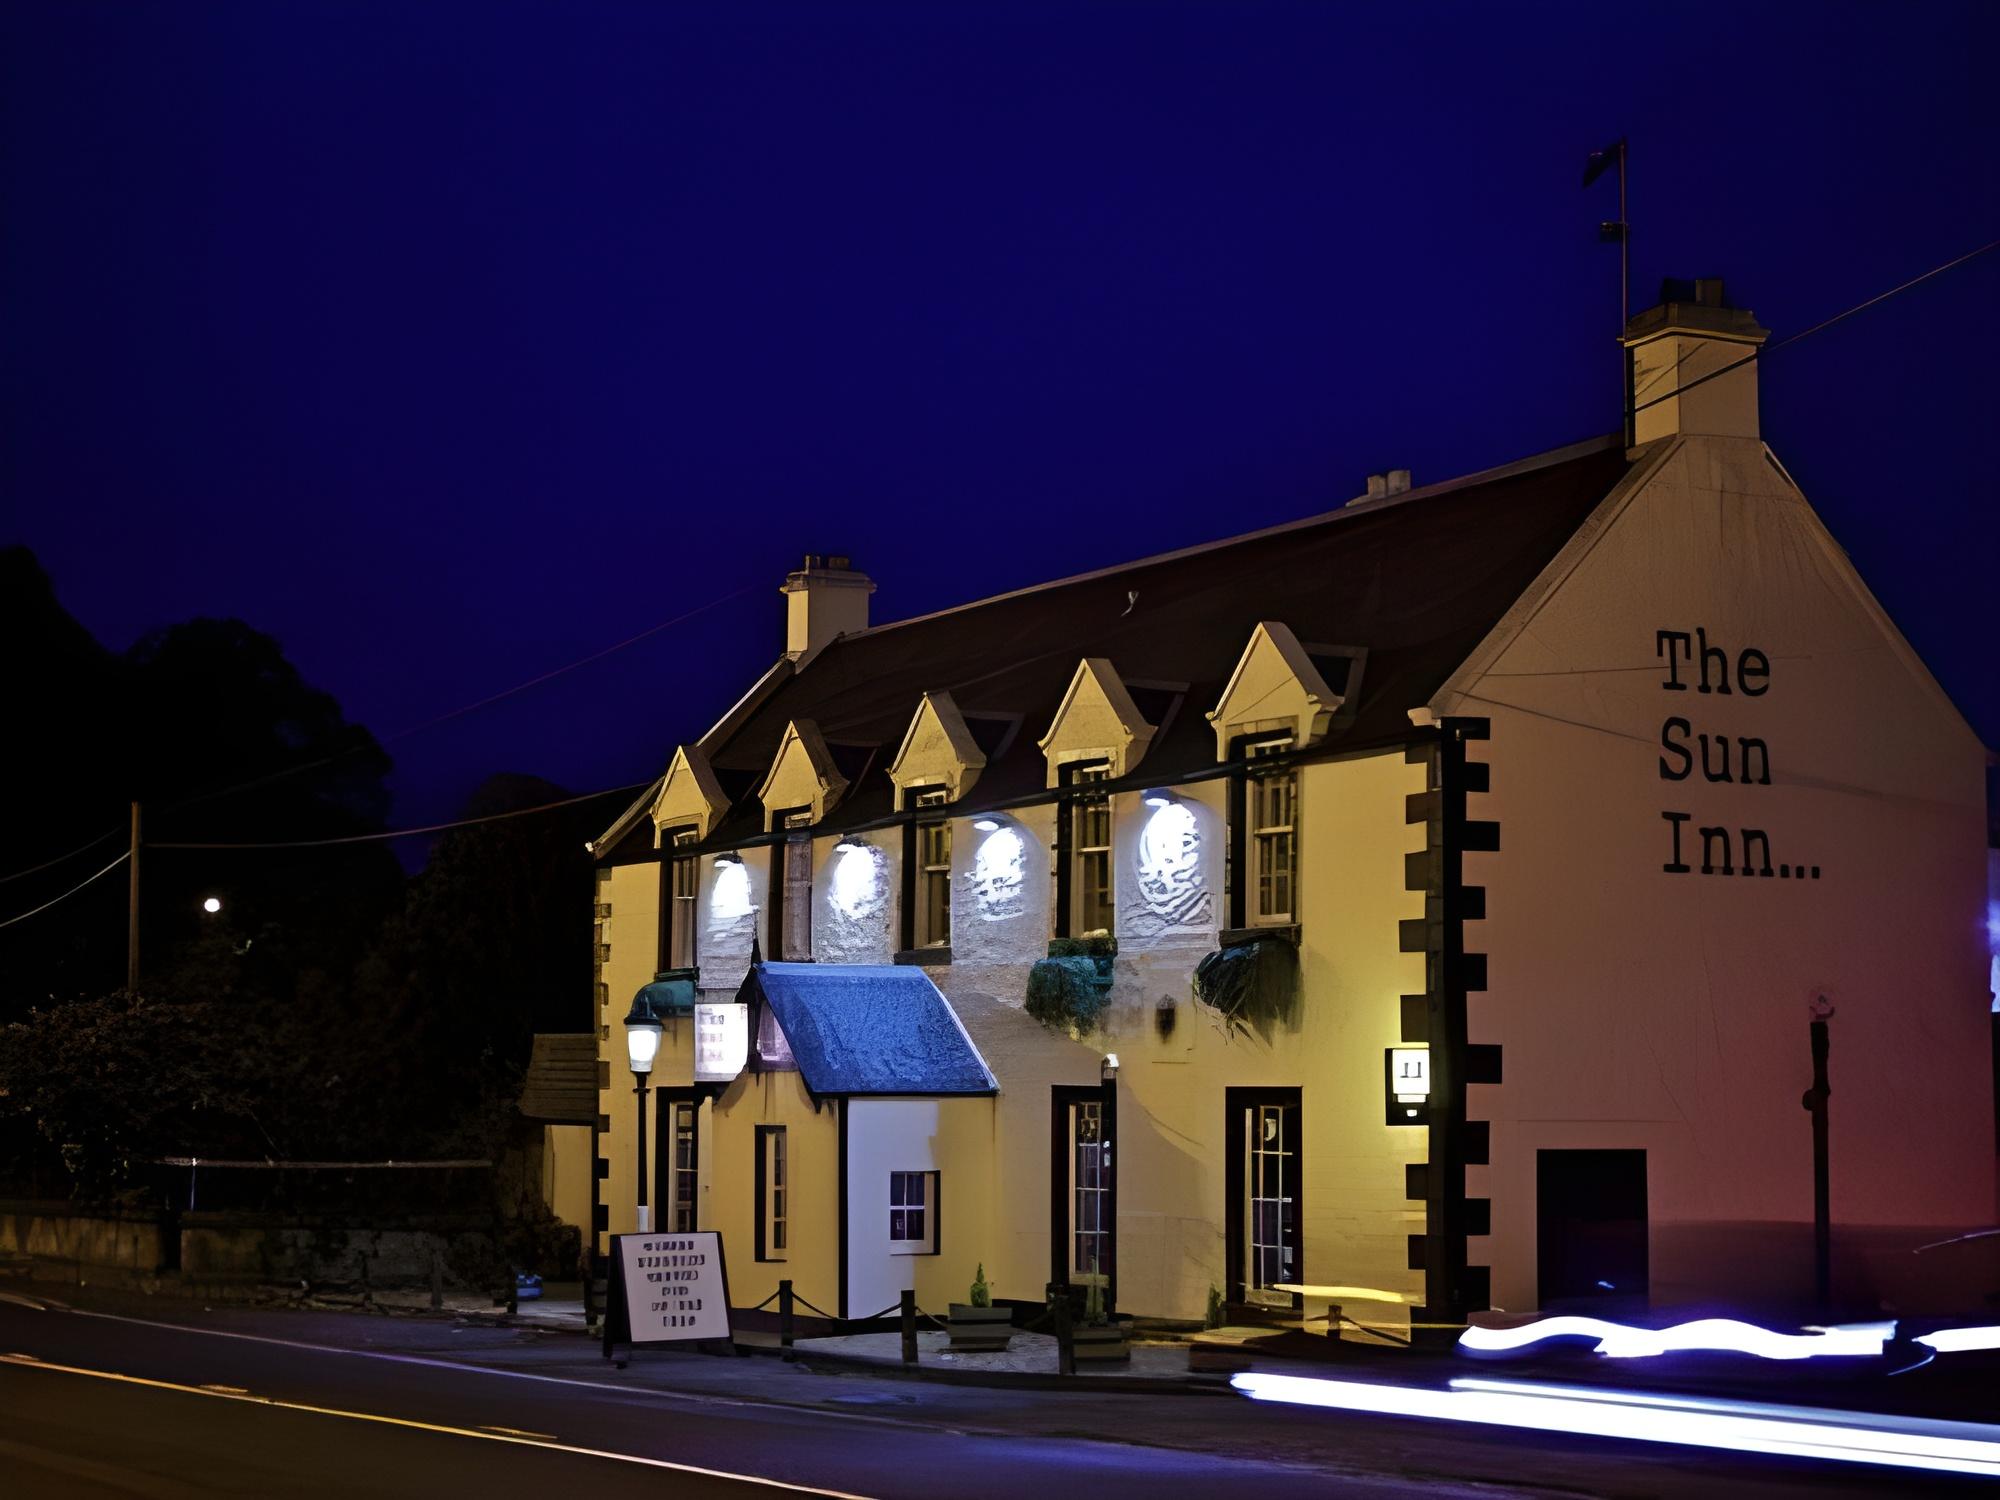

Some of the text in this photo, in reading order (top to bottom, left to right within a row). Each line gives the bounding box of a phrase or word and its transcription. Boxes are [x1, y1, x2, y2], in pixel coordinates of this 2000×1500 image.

[1656, 627, 1770, 697] The
[1659, 716, 1771, 785] Sun
[1661, 811, 1820, 879] Inn...
